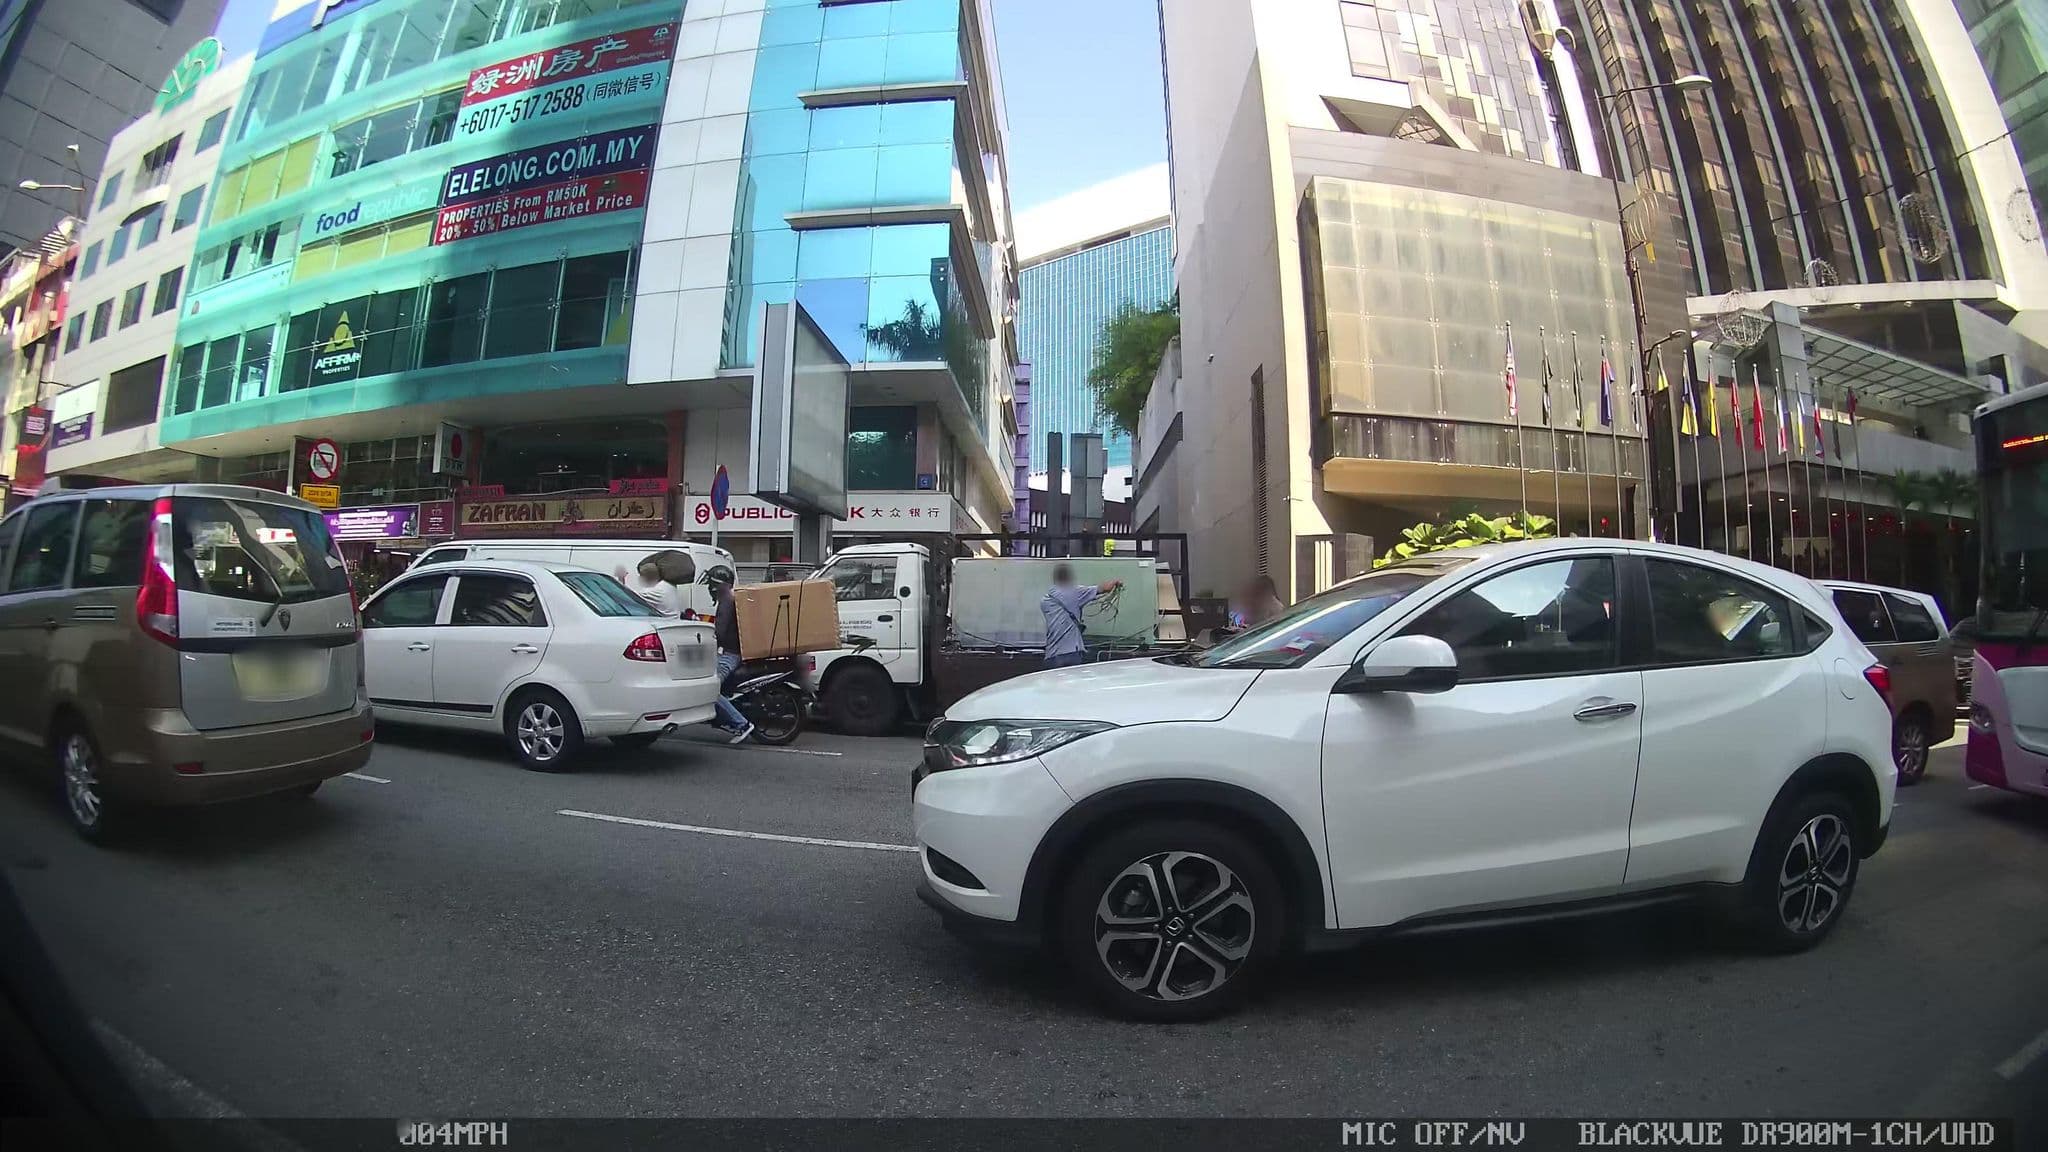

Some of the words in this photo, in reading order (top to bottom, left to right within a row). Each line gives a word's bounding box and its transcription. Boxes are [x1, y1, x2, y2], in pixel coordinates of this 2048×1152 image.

[447, 134, 644, 199] ELELONG.COM.MY
[315, 201, 362, 234] food
[439, 224, 461, 241] 20%
[473, 217, 496, 233] 50%
[501, 210, 539, 228] Below
[544, 199, 590, 220] Market
[596, 194, 633, 211] Price
[442, 200, 509, 226] PROPERTIES
[513, 195, 541, 210] From
[546, 184, 588, 203] RM50K
[468, 501, 546, 522] ZAFRAN
[871, 506, 940, 518] 大众银行
